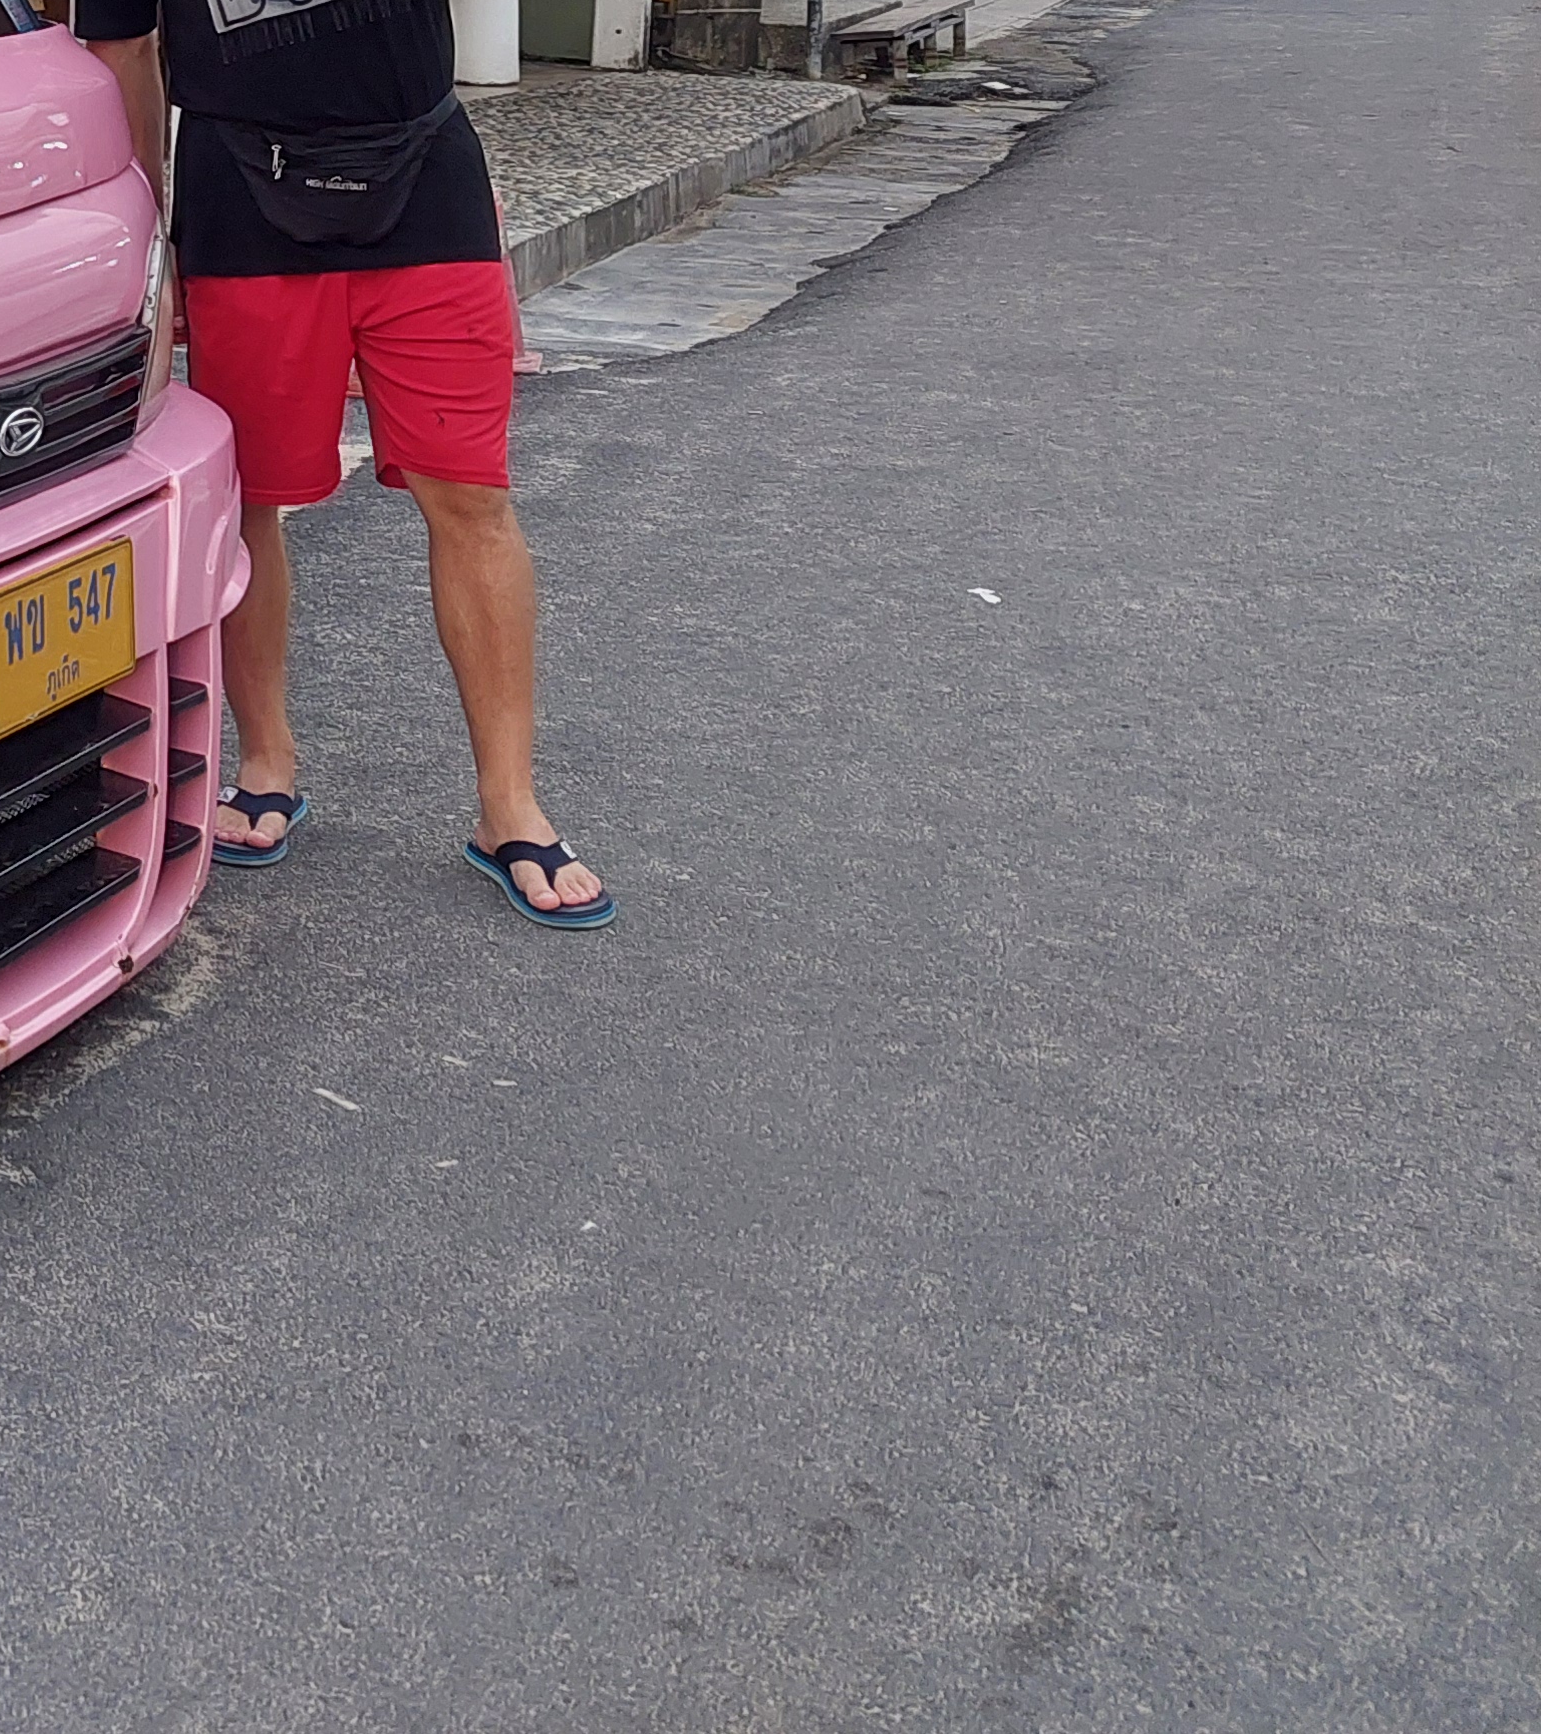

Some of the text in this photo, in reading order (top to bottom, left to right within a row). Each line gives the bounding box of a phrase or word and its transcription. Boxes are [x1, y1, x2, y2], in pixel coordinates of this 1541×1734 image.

[67, 561, 117, 634] 547
[46, 653, 81, 702] ภูเก็ต
